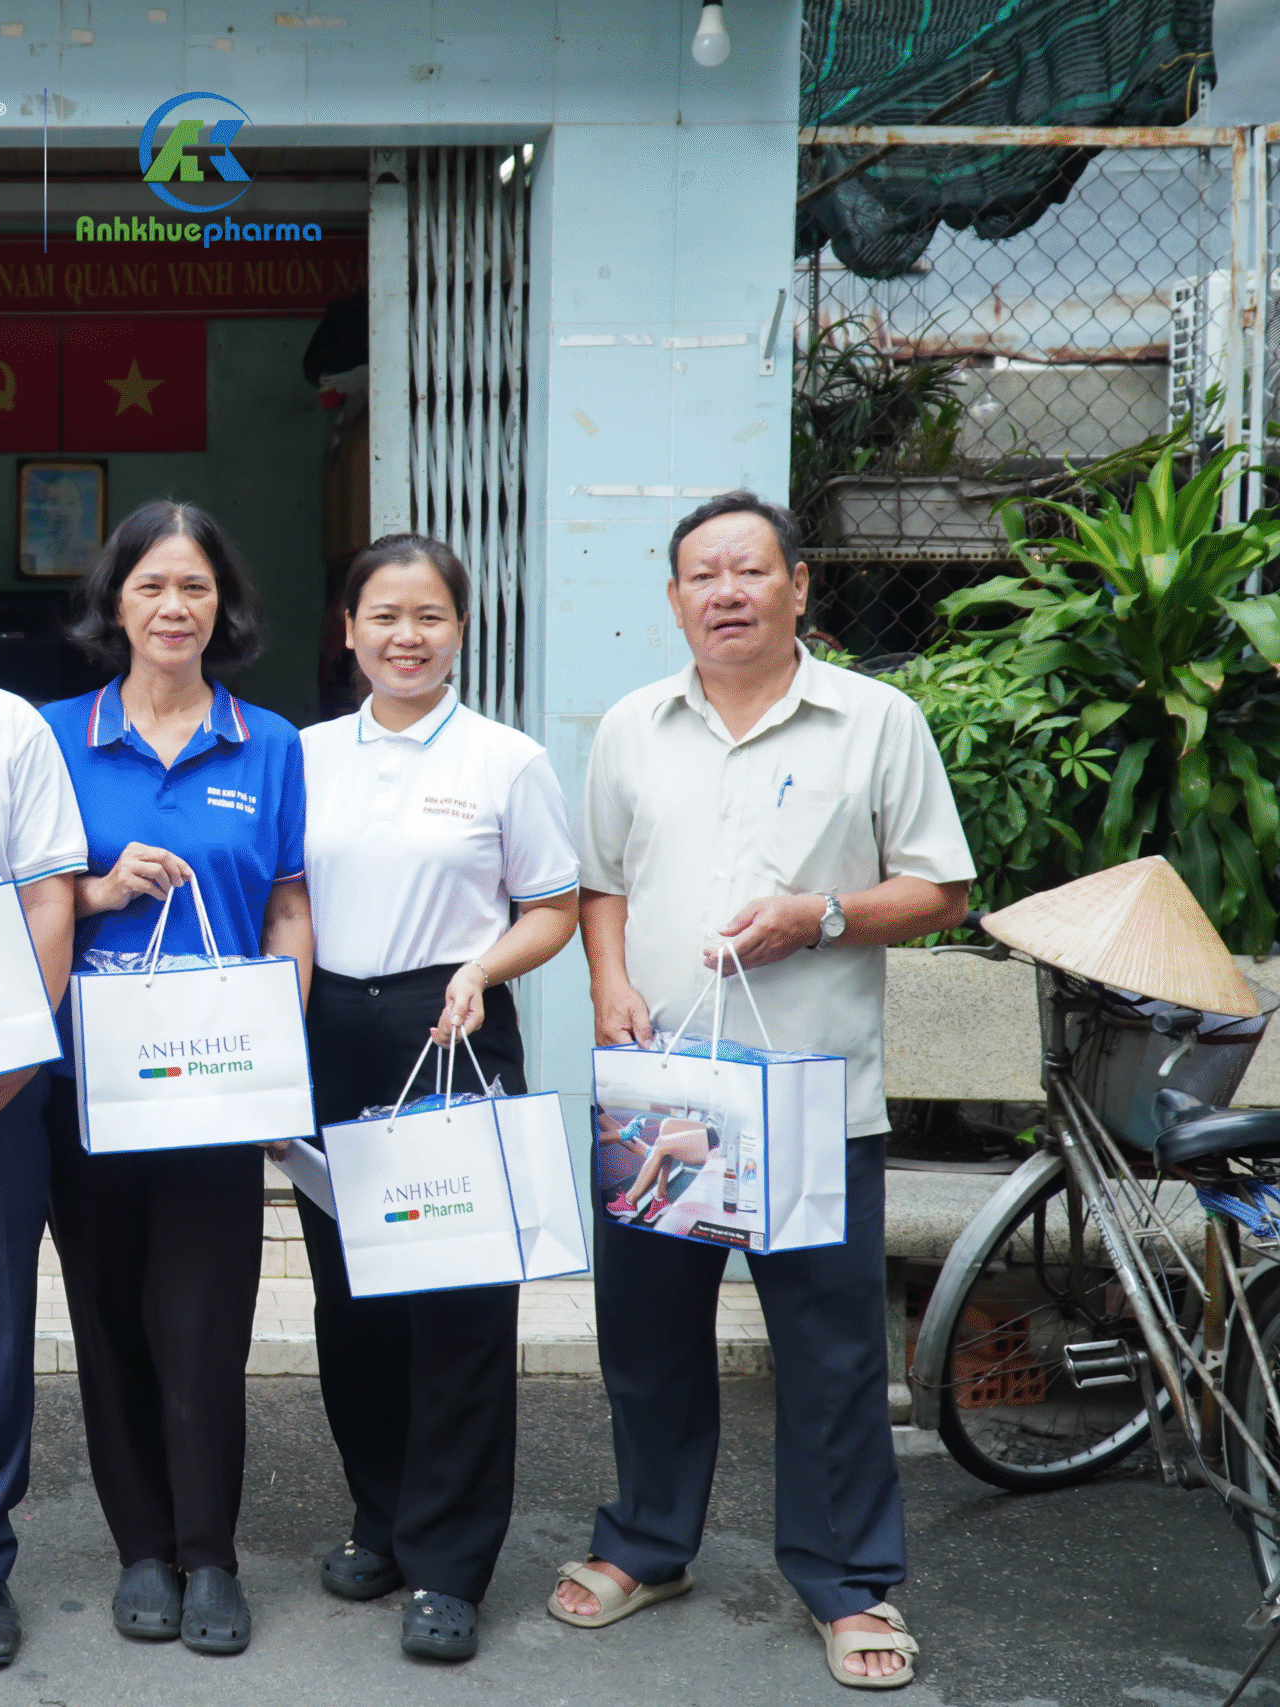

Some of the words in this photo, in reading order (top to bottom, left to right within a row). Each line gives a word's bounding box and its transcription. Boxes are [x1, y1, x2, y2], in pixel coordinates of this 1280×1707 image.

[63, 261, 160, 306] QUANG
[167, 261, 235, 297] VINH
[242, 250, 324, 295] MUÔN
[187, 1060, 254, 1076] Pharma
[423, 1200, 474, 1219] Pharma
